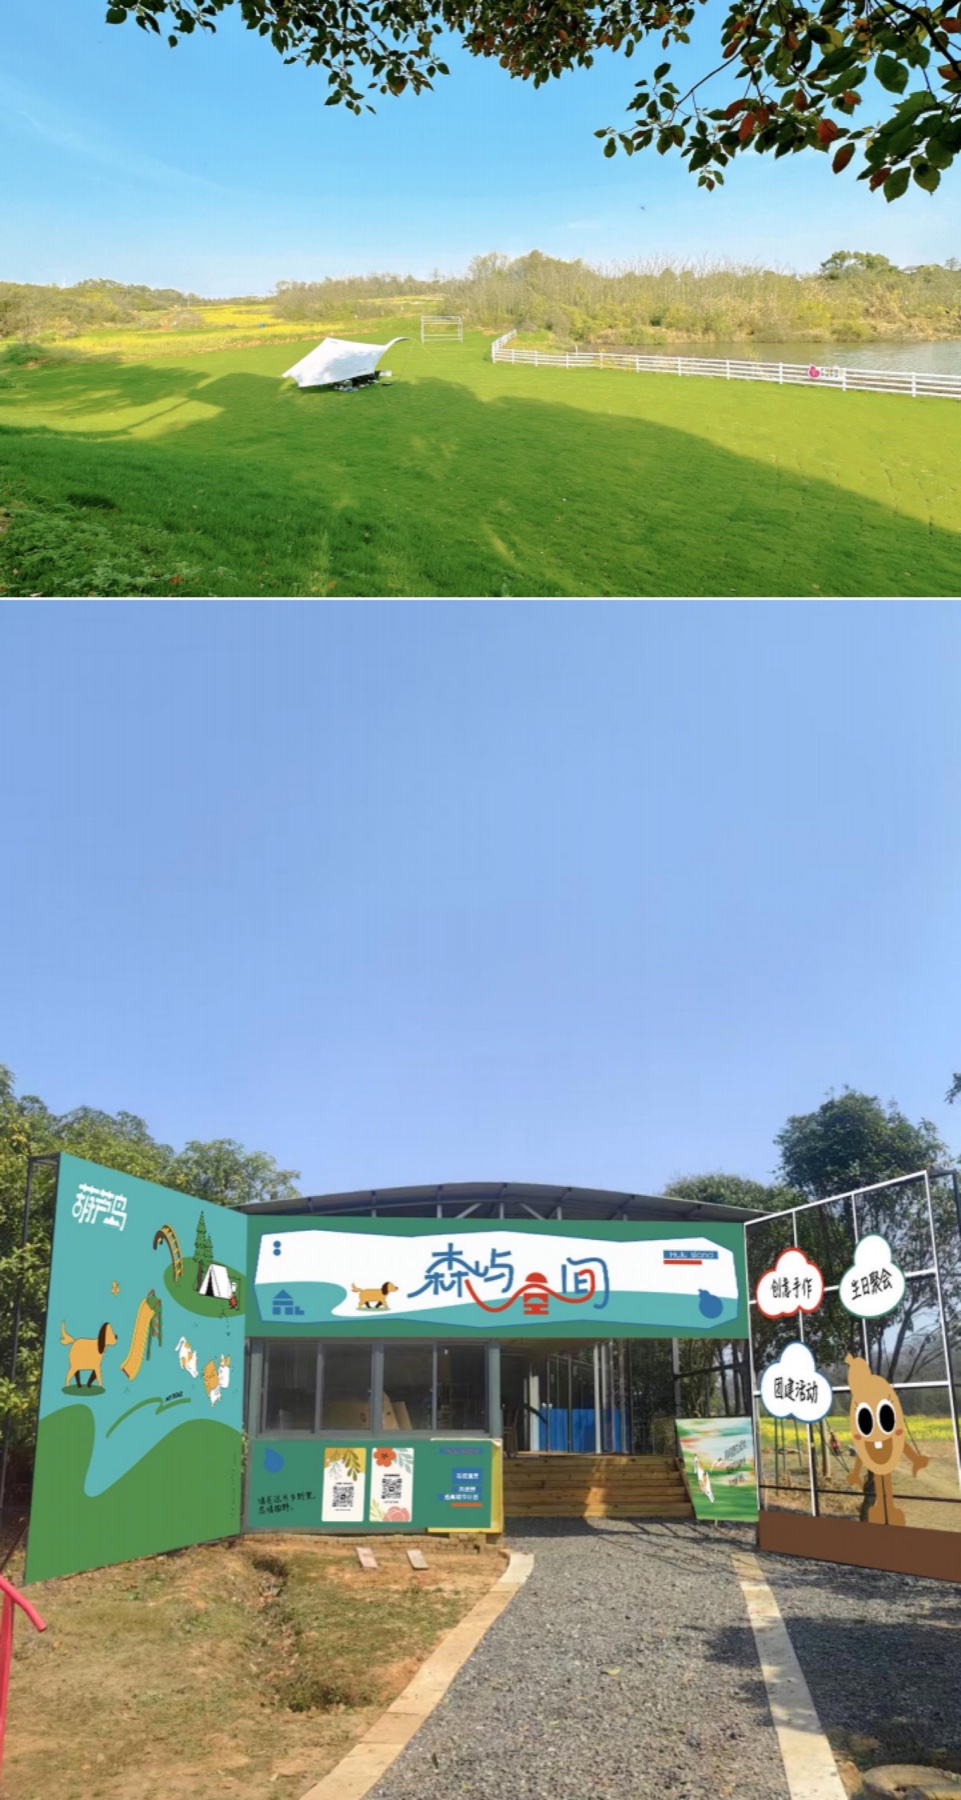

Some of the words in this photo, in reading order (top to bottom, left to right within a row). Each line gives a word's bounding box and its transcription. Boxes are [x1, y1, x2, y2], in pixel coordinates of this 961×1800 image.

[72, 1183, 128, 1231] 葫芦岛
[771, 1277, 813, 1299] 创意手作
[851, 1267, 893, 1301] 生日聚会
[774, 1376, 818, 1403] 团建活动
